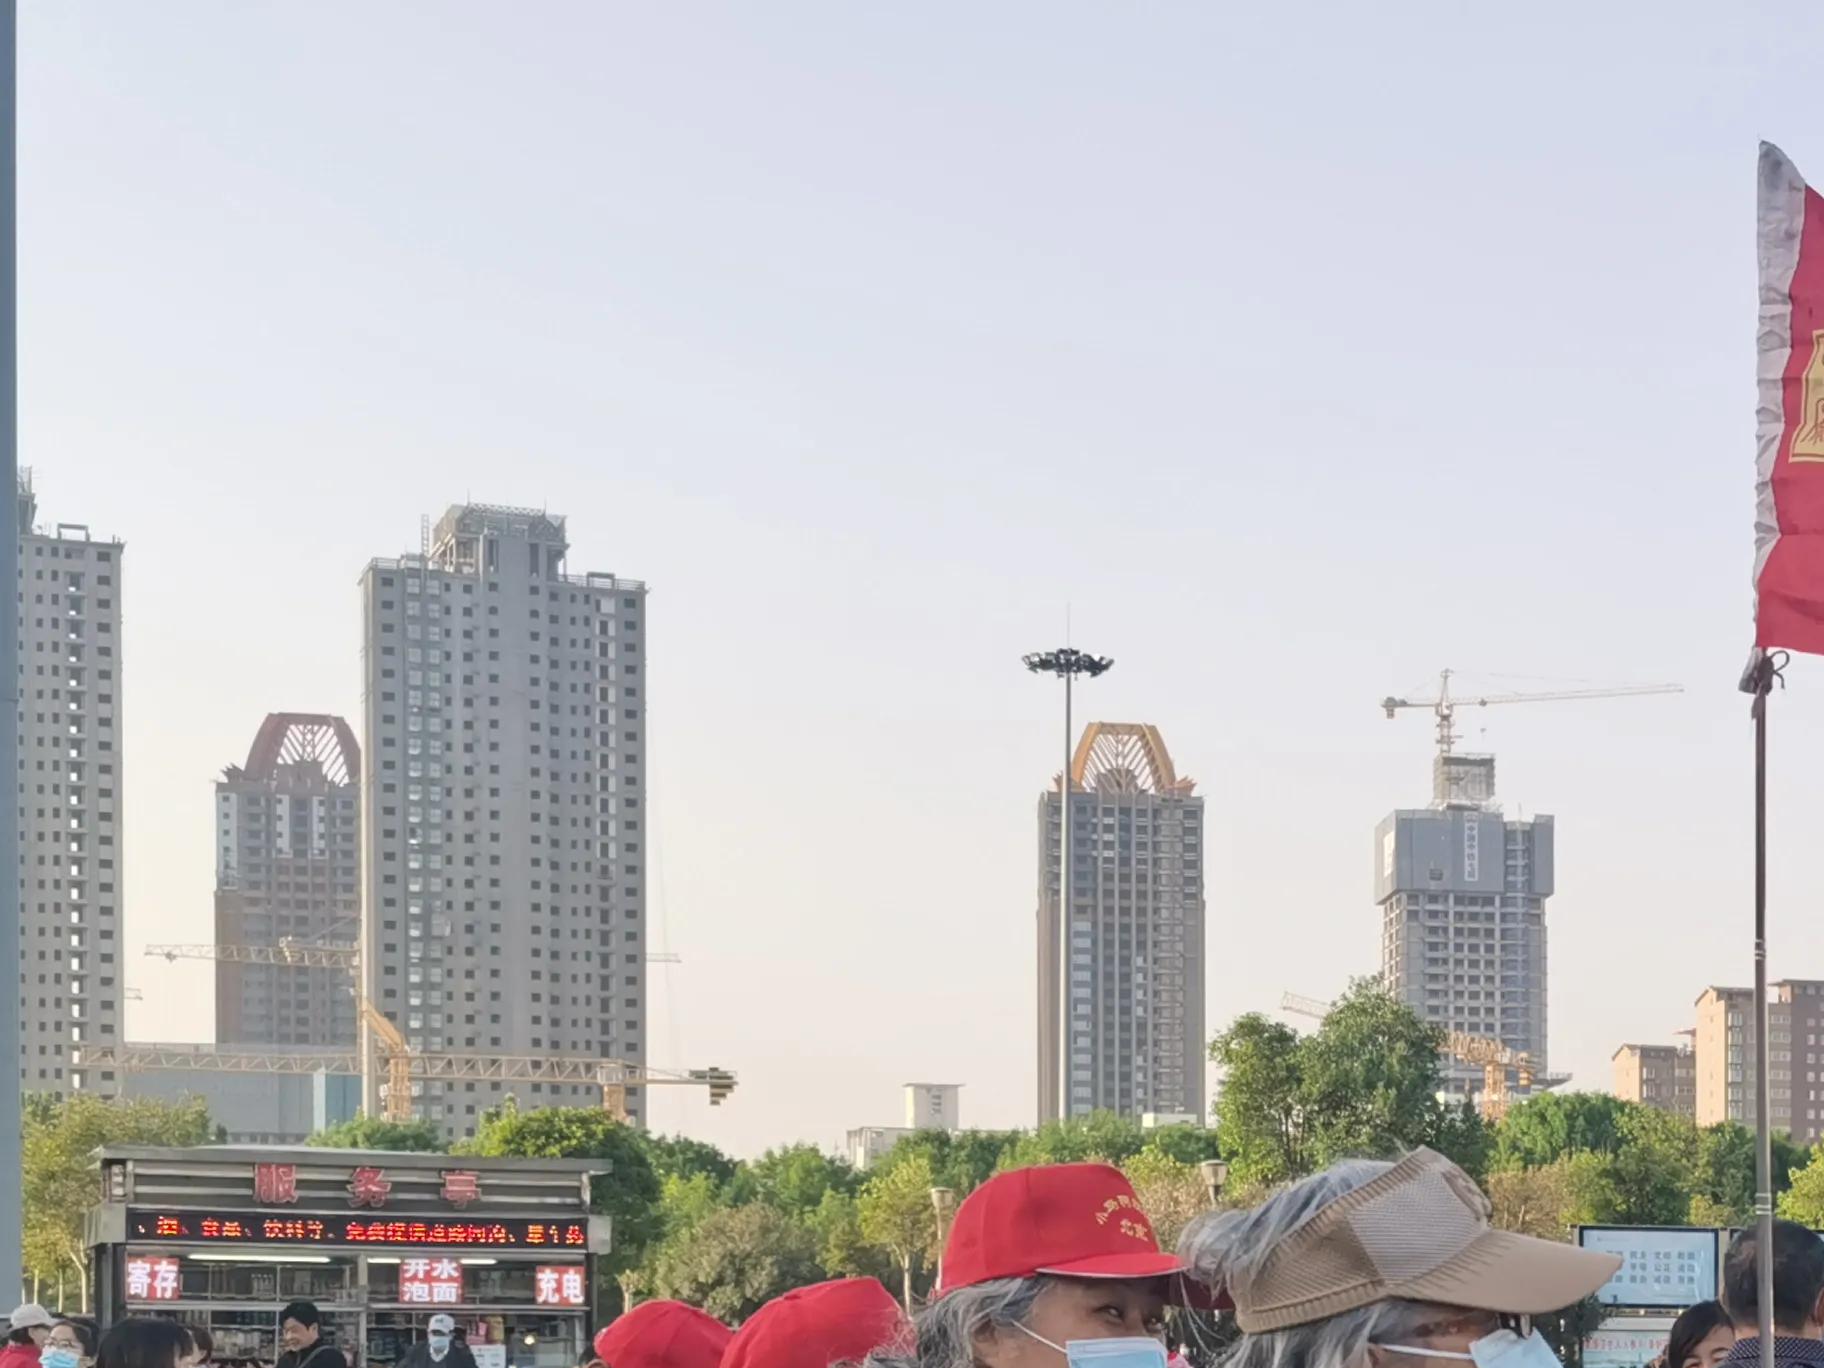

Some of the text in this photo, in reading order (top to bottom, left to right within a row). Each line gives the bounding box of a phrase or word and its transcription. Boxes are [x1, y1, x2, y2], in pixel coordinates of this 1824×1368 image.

[127, 1260, 179, 1300] 寄存
[403, 1257, 461, 1279] 开水
[403, 1280, 461, 1303] 泡面
[536, 1268, 586, 1304] 充电
